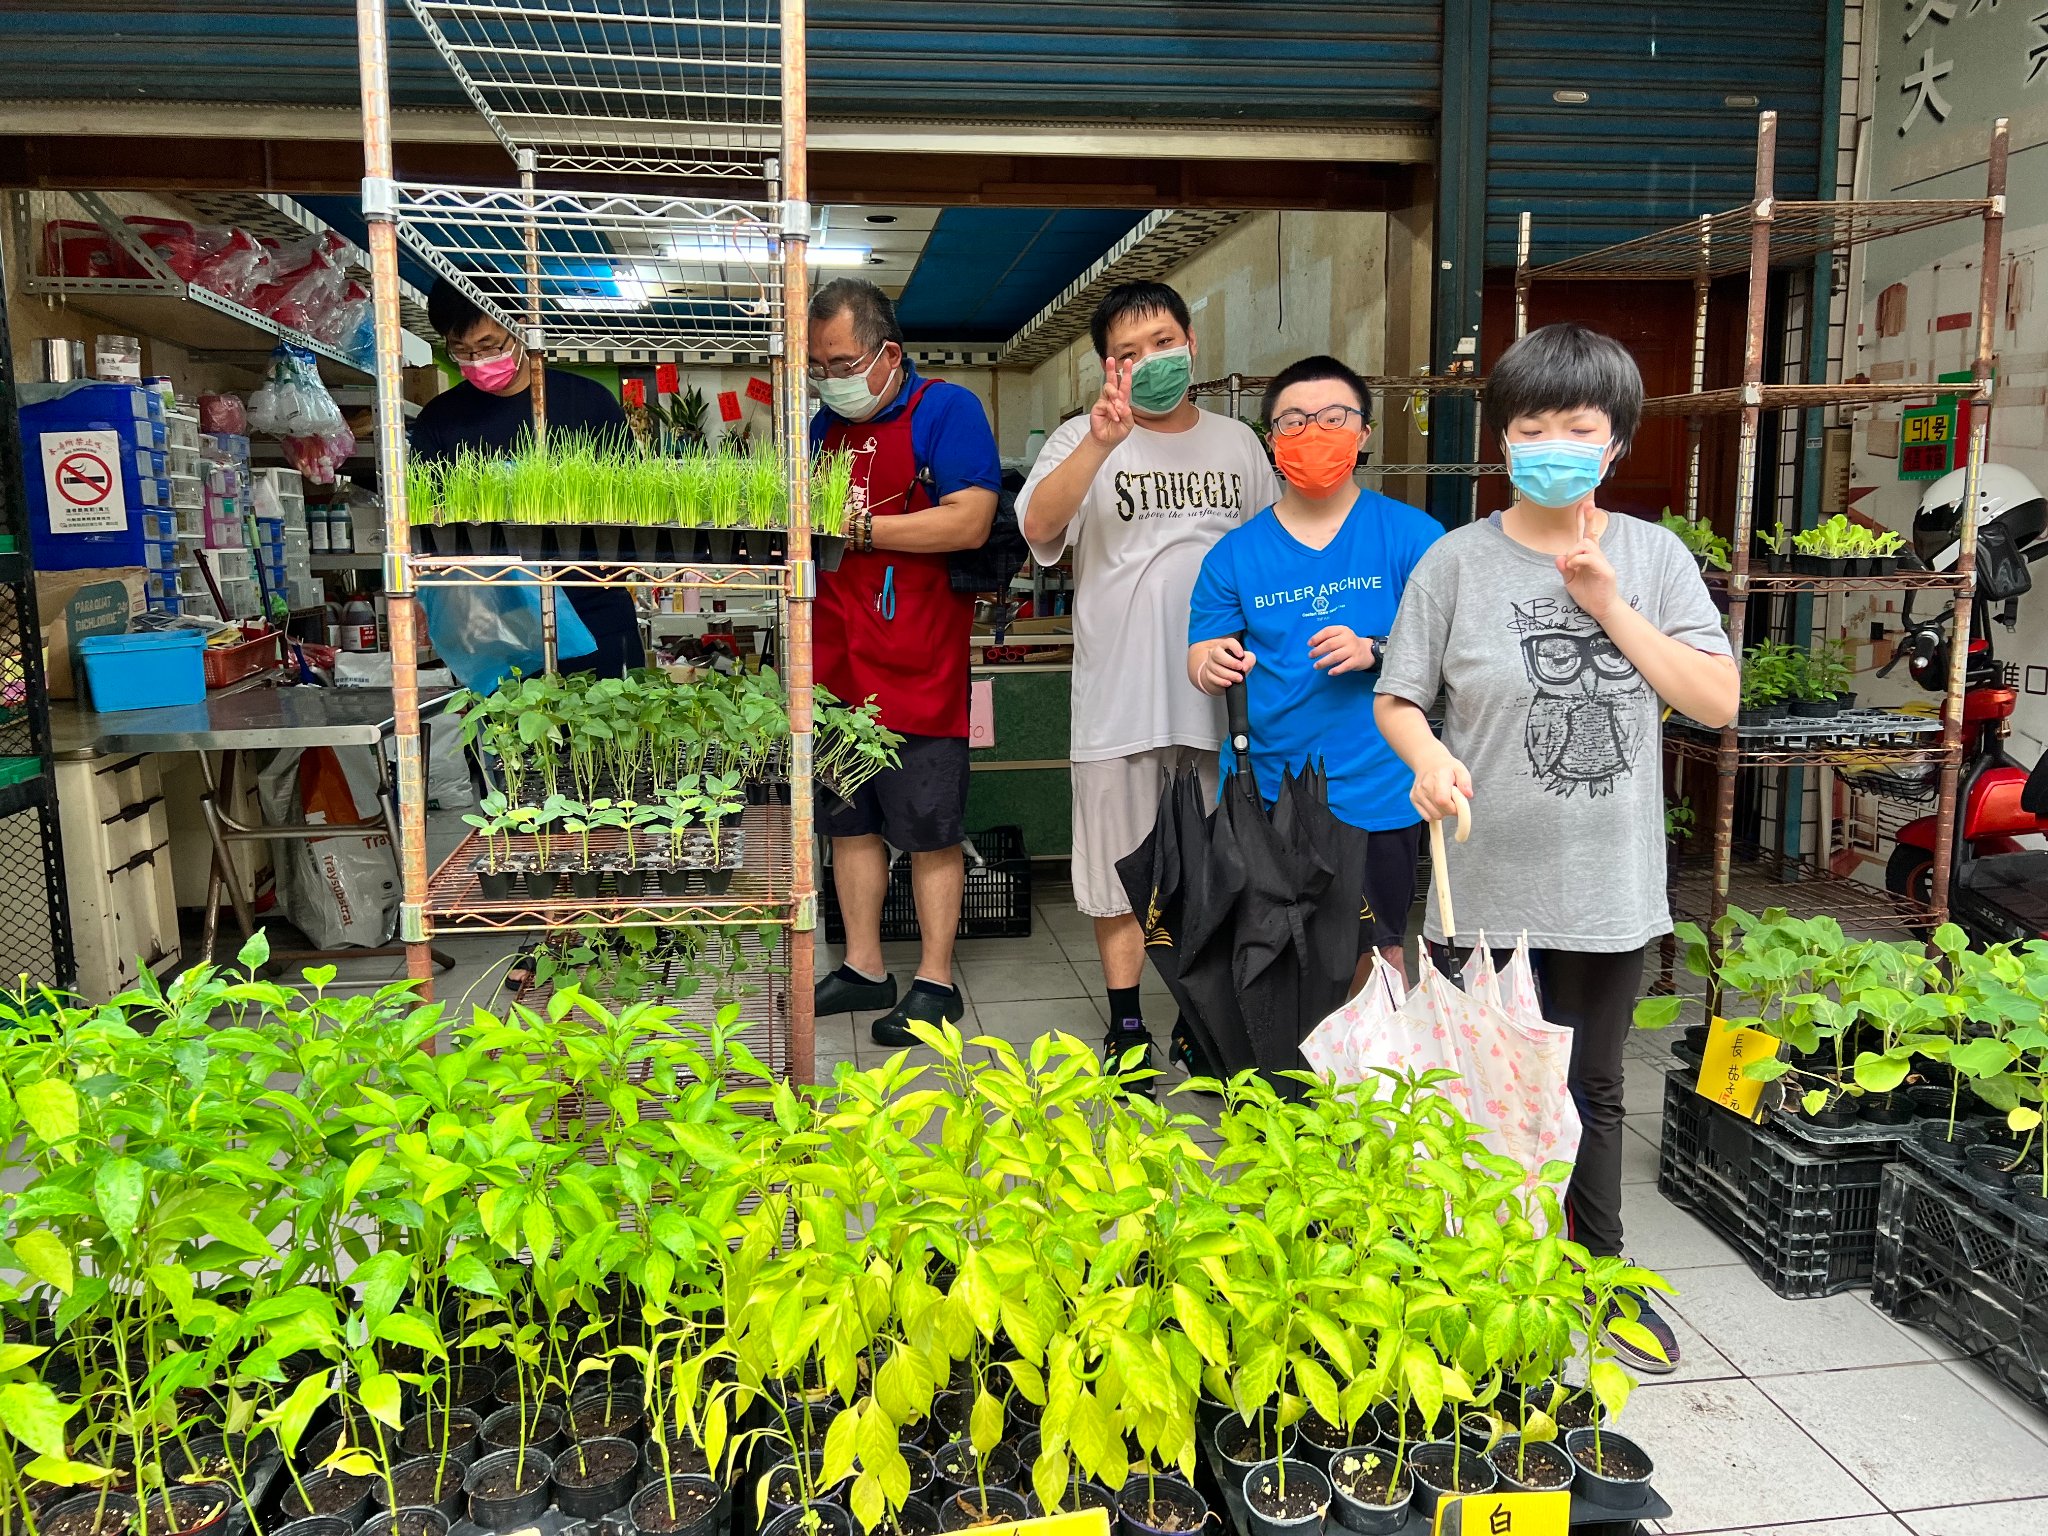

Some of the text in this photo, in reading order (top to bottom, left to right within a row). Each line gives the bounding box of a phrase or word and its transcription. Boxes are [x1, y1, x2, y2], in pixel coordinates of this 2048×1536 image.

[1115, 470, 1243, 522] STRUGGLE
[1138, 511, 1165, 520] above
[1168, 510, 1183, 519] the
[75, 595, 112, 614] PARAQUAT
[1254, 576, 1382, 609] BUTLER ARCHIVE
[323, 853, 353, 926] Traysubstrat
